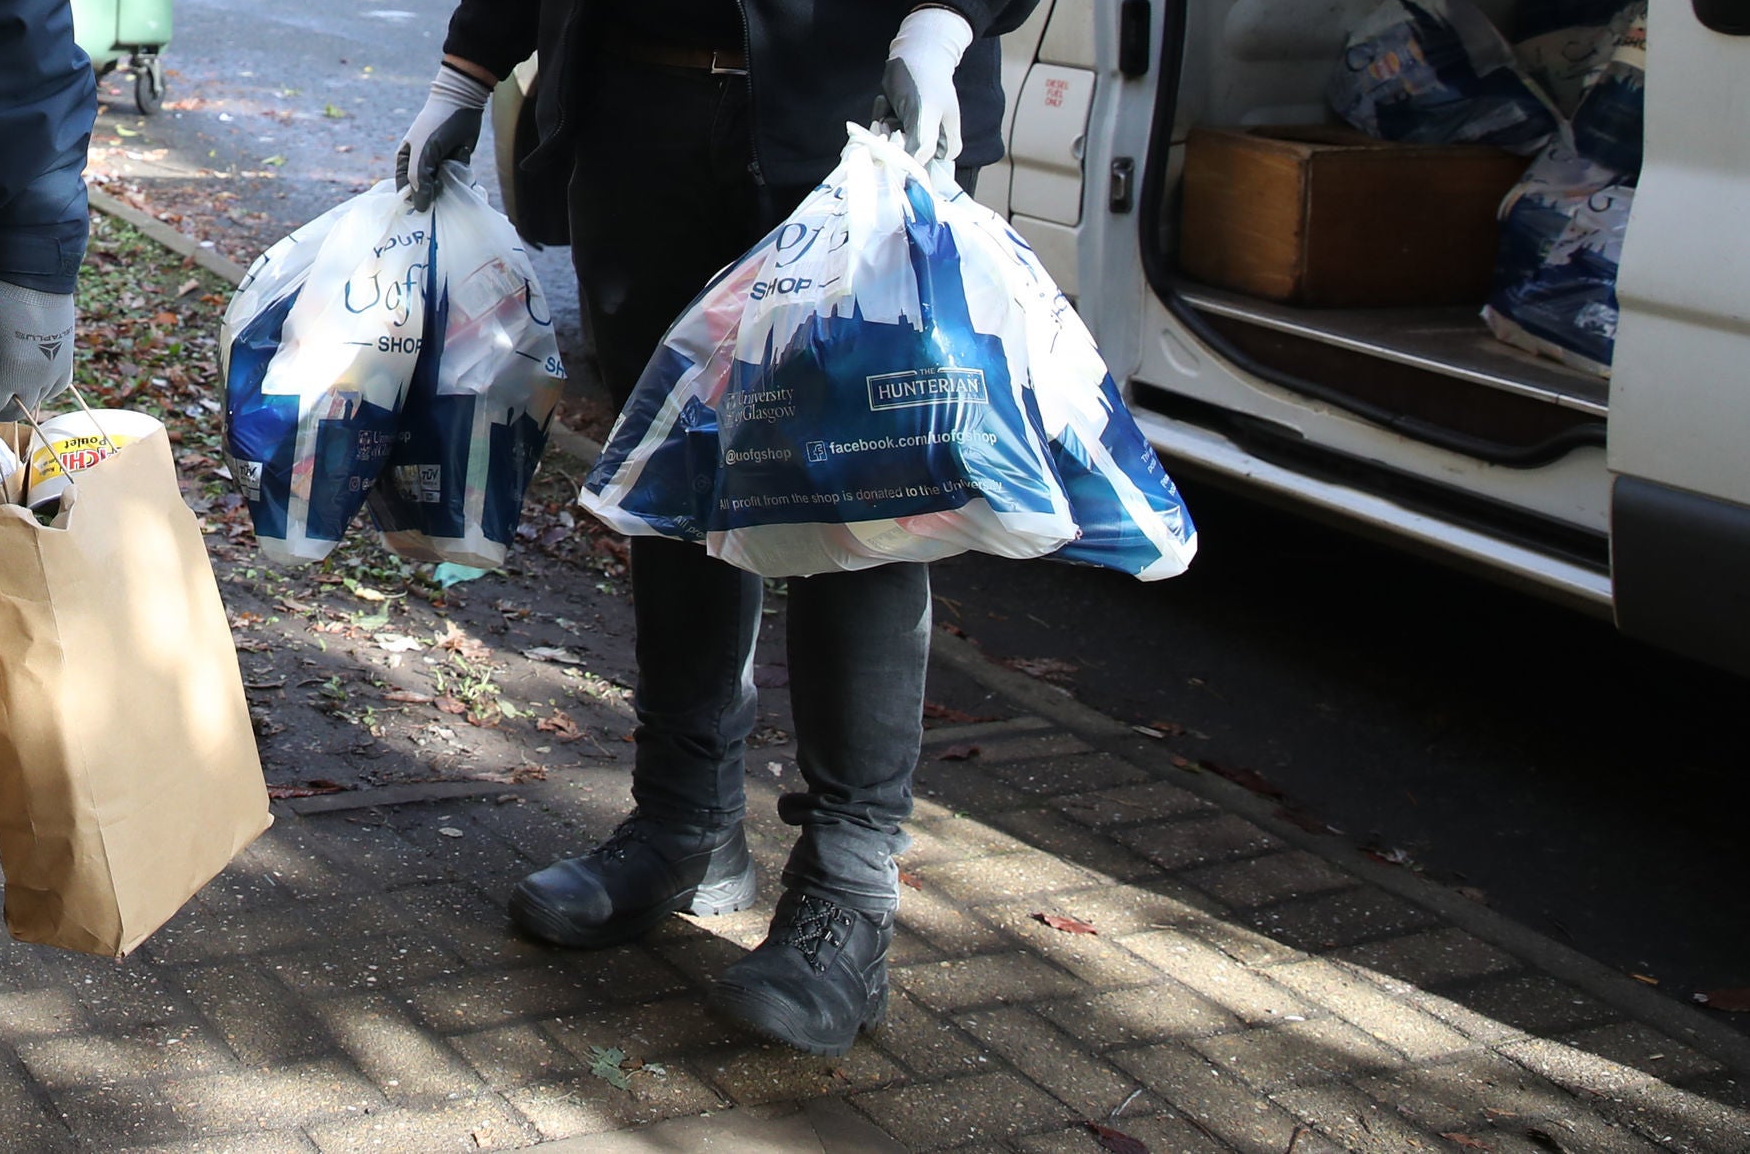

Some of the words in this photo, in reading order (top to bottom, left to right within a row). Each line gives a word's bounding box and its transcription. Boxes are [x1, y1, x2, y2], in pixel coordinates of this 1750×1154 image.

[750, 277, 812, 301] SHOP
[919, 367, 935, 375] THE
[738, 385, 794, 406] University
[878, 377, 980, 400] HUNTERIAN
[743, 403, 796, 424] Glasgow
[725, 447, 792, 465] @uofgshop
[719, 498, 730, 510] All
[732, 496, 761, 511] profit
[763, 494, 790, 507] from
[791, 493, 809, 504] the
[811, 491, 840, 505] shop
[842, 490, 854, 501] is
[855, 486, 903, 501] donated
[905, 487, 918, 497] to
[919, 484, 940, 496] the
